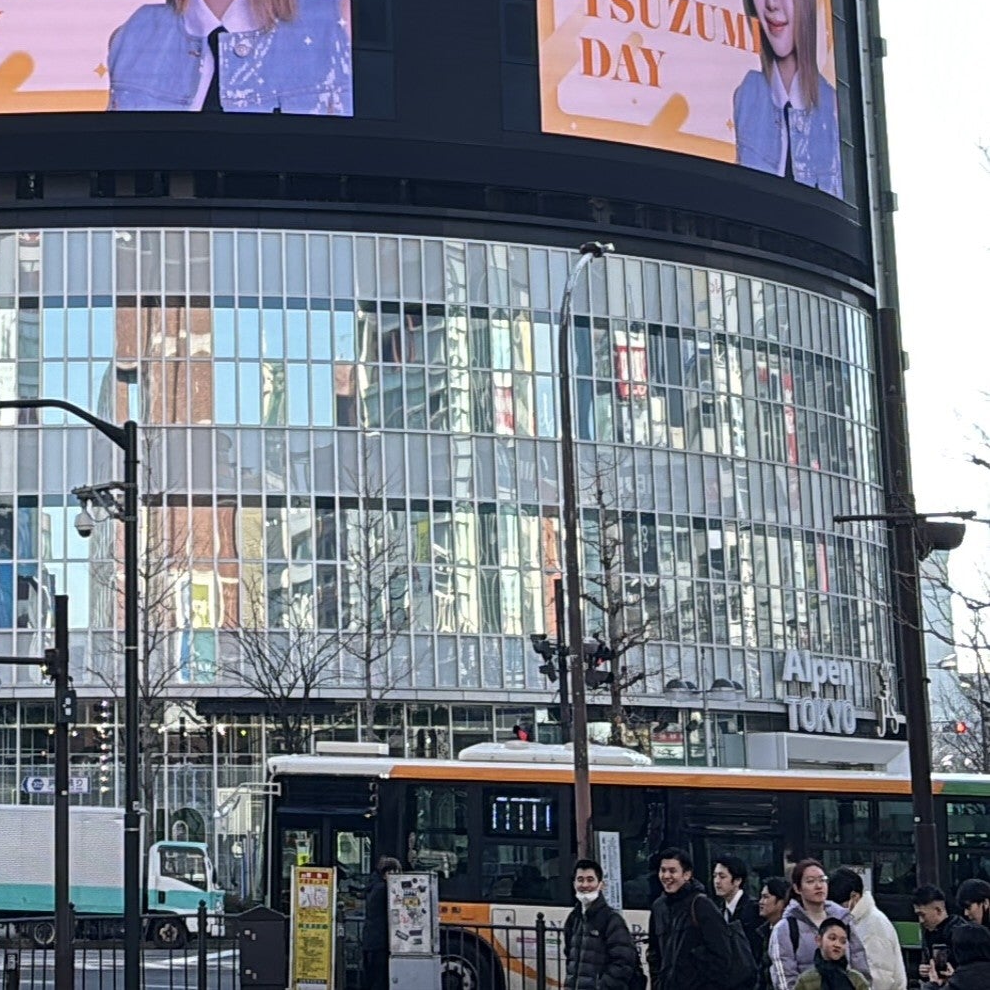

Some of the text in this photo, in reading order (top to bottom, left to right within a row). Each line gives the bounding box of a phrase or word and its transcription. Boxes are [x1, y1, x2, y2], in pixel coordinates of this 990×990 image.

[579, 36, 666, 89] DAY
[782, 647, 853, 693] Alpen
[784, 694, 856, 735] TOKYO
